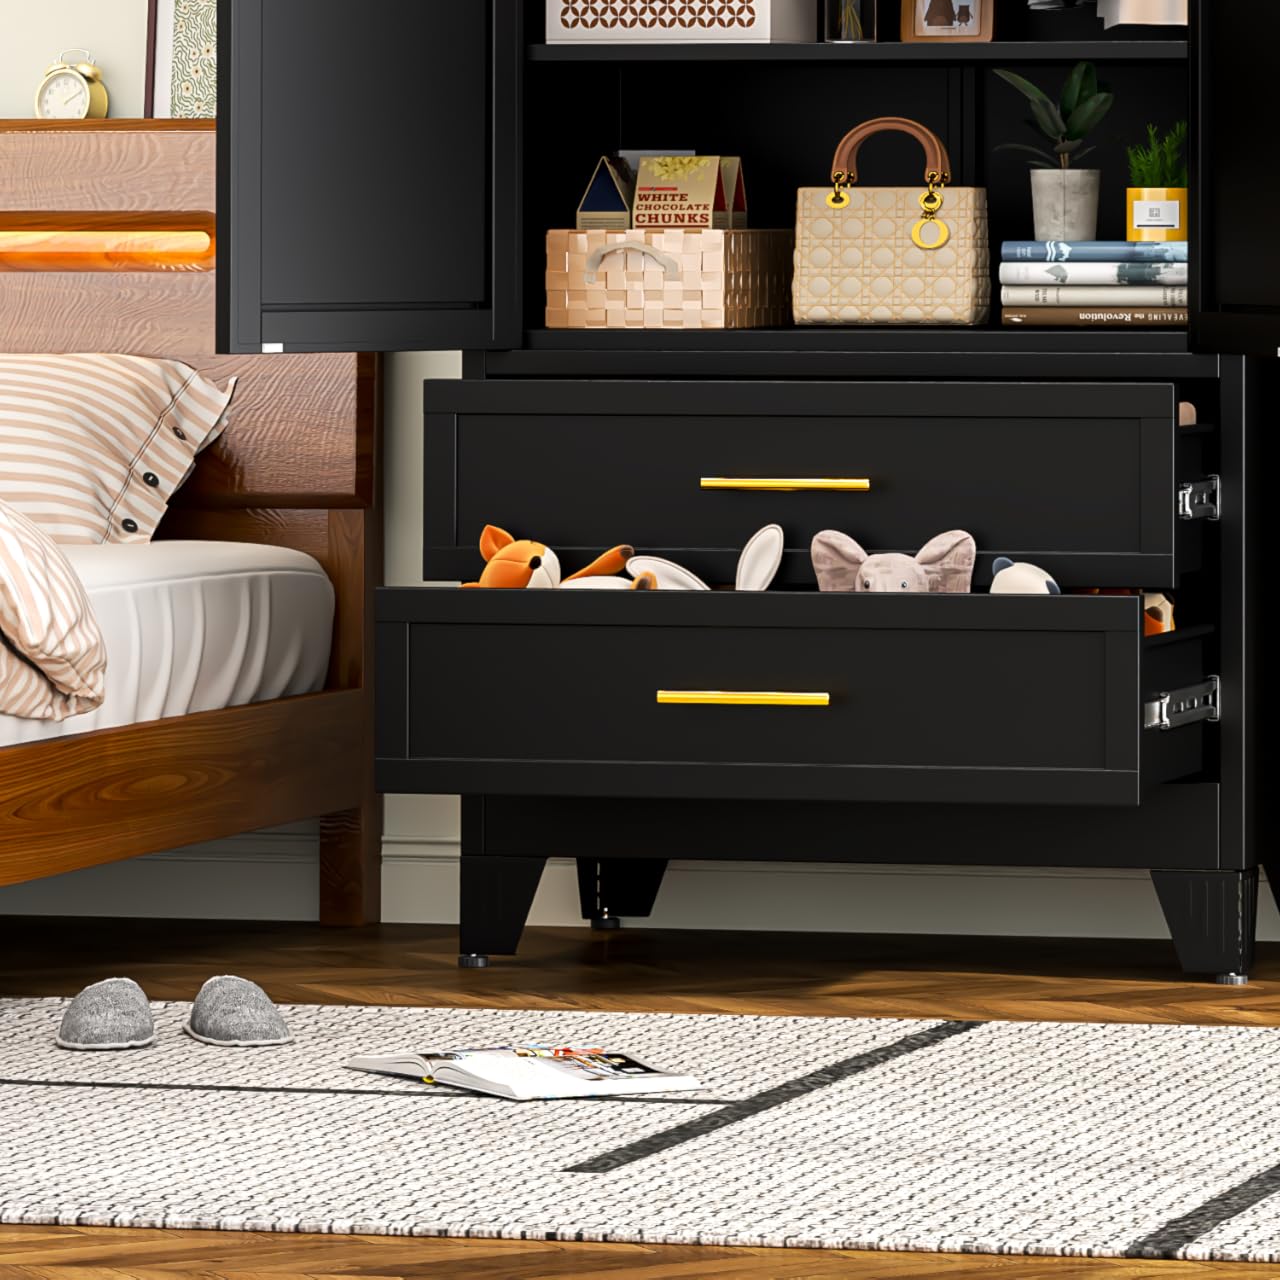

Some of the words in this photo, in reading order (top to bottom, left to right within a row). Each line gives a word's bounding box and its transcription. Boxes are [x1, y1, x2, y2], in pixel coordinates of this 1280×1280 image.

[638, 193, 689, 202] WHITE
[635, 213, 710, 224] CHUNKS
[1079, 312, 1132, 322] Revolution
